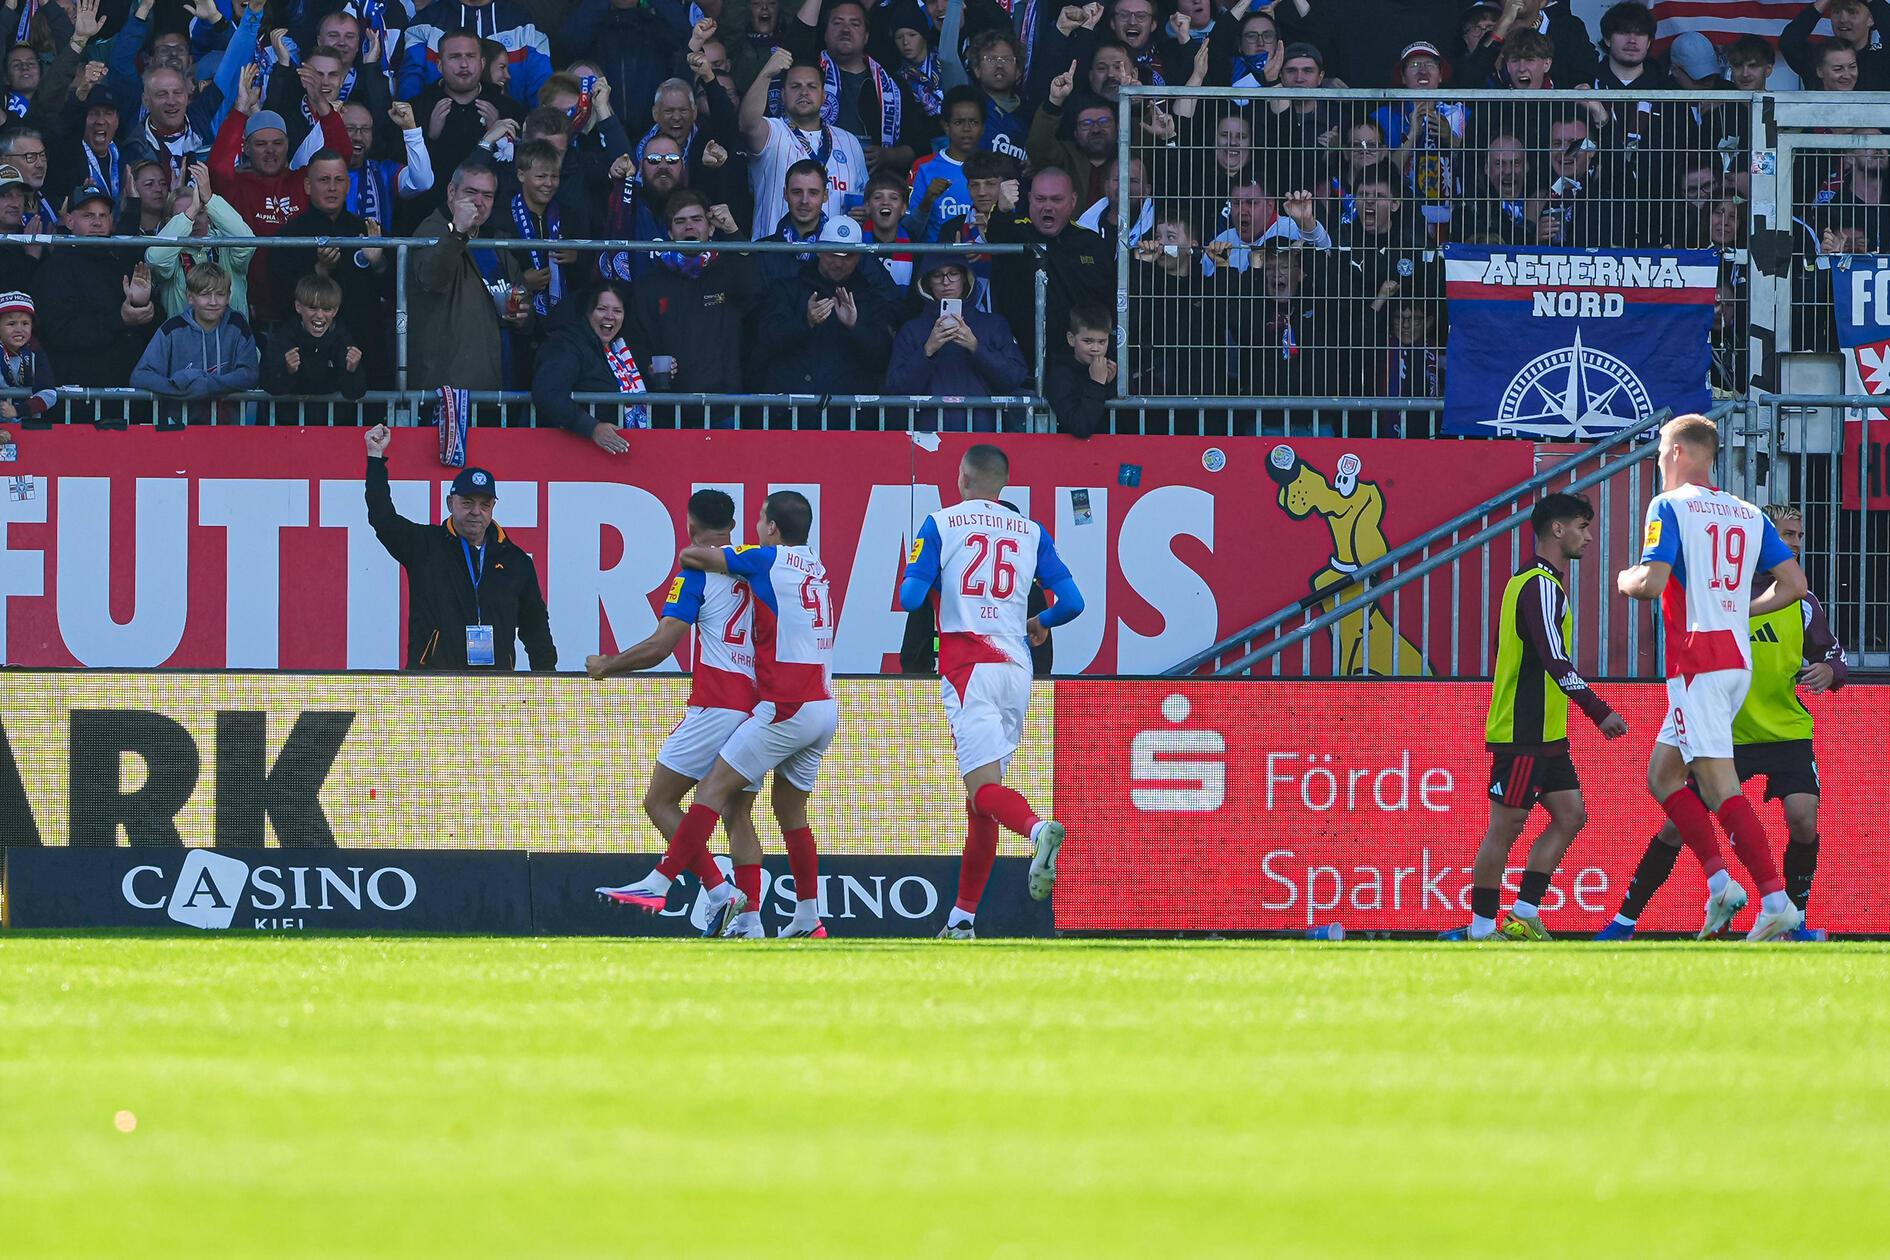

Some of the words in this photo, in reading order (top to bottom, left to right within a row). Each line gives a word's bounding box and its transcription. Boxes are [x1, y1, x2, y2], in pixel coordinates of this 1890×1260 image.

[1481, 253, 1685, 289] AETERNA
[1532, 291, 1625, 318] NORD
[948, 514, 1003, 529] HOLSTEIN
[1006, 517, 1030, 535] KIEL
[1686, 501, 1731, 517] HOLSTEIN
[1731, 507, 1755, 520] KIEL
[959, 531, 1020, 601] 26
[1704, 522, 1747, 594] 19
[980, 606, 999, 619] ZEC
[1266, 749, 1455, 812] Förde
[121, 864, 418, 911] CASINO
